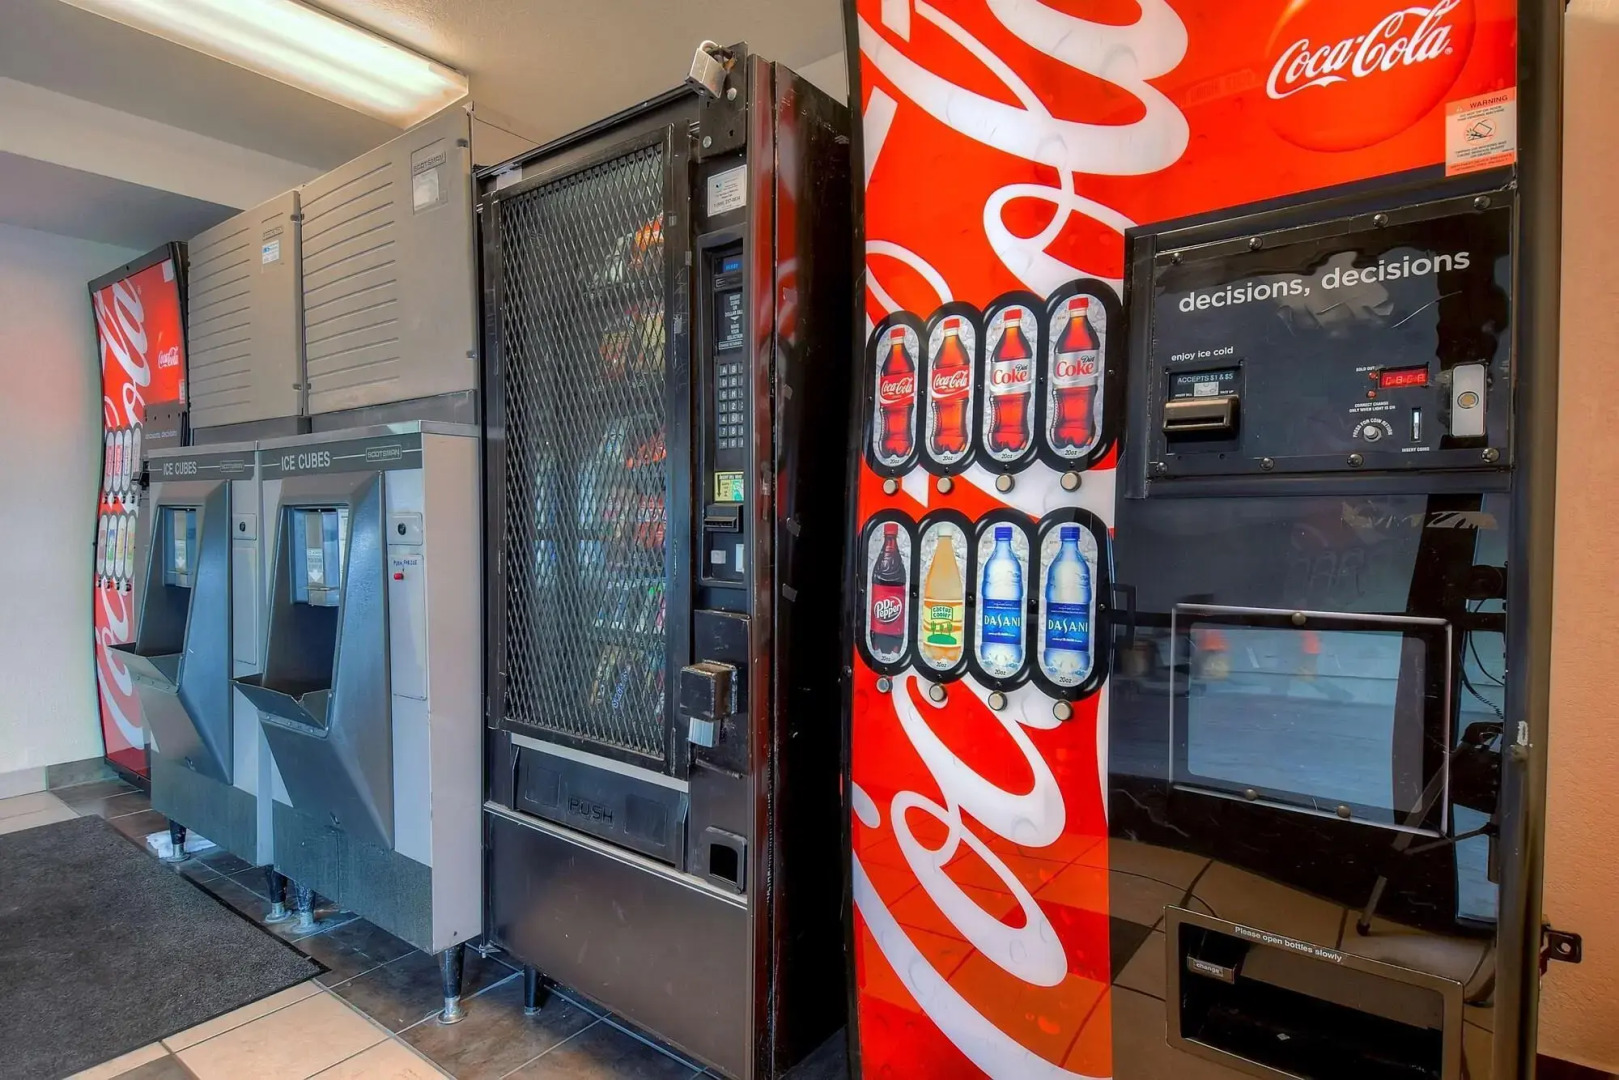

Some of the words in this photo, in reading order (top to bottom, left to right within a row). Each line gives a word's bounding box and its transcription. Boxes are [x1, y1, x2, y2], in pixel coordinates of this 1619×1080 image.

[1266, 0, 1461, 99] Coca-Cola
[1470, 95, 1508, 108] WARNING
[1179, 278, 1311, 313] decisions,
[1321, 250, 1470, 290] decisions
[1171, 353, 1195, 361] enjoy
[1213, 346, 1234, 355] cold
[993, 368, 1028, 385] Coke
[1056, 360, 1095, 378] Coke
[880, 378, 914, 396] Coca-Cola
[932, 369, 970, 390] Coca-Cola
[1177, 375, 1209, 383] ACCEPTS
[163, 463, 174, 476] ICE
[175, 461, 197, 475] CUBES
[281, 455, 295, 470] ICE
[298, 451, 330, 469] CUBES
[876, 601, 900, 619] Pepper
[884, 599, 895, 609] Dr
[984, 614, 1020, 628] DASANI
[1048, 618, 1088, 633] DASANI
[568, 797, 613, 823] PUSH
[1235, 926, 1260, 939] Please
[1262, 935, 1282, 945] open
[1284, 939, 1313, 953] bottles
[1314, 948, 1342, 963] slowly
[1196, 962, 1220, 974] change
